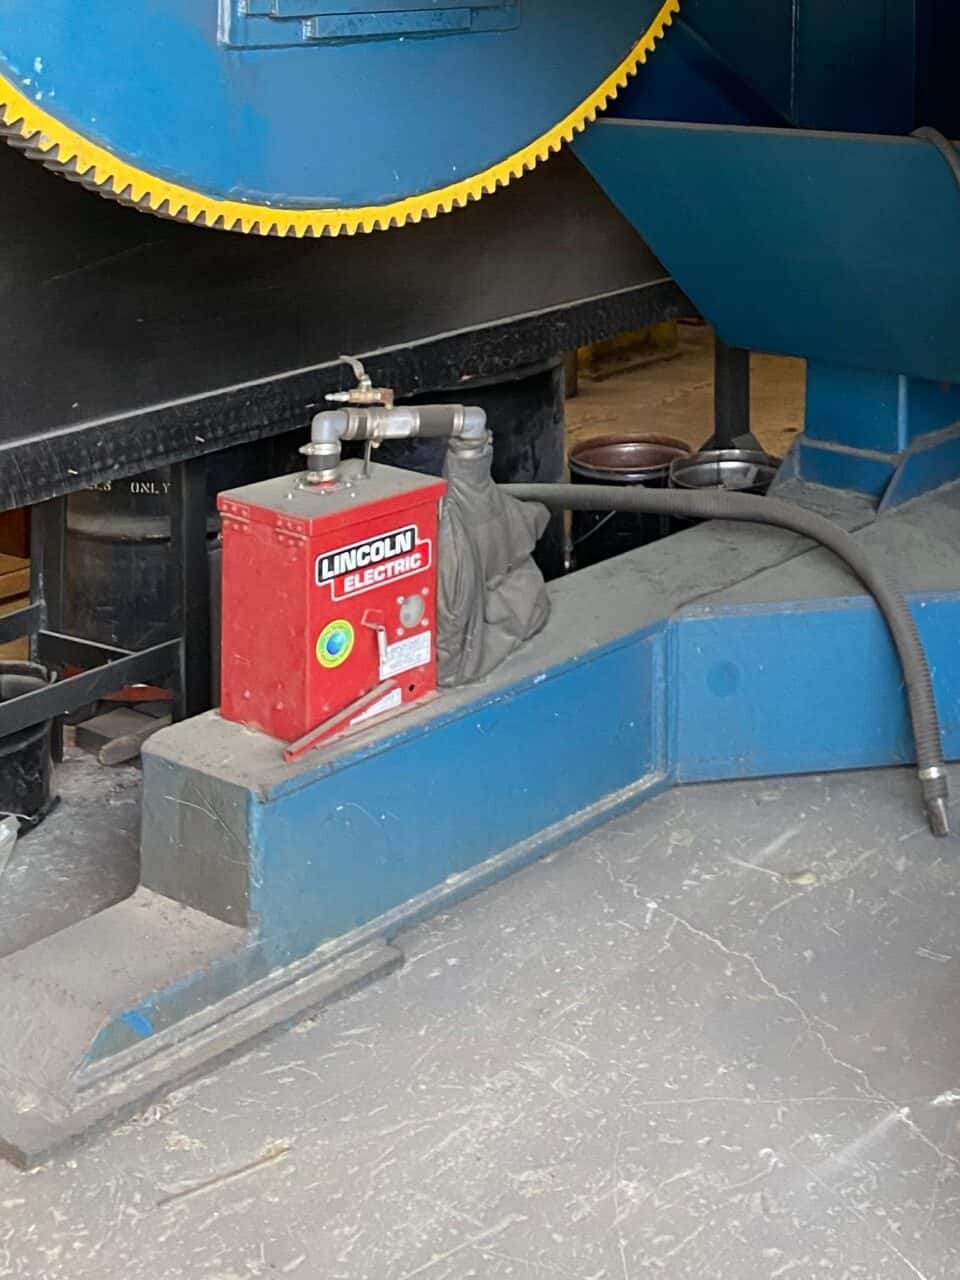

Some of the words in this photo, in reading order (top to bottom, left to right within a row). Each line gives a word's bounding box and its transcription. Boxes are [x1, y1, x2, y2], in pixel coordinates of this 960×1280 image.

[130, 482, 171, 494] ONLY
[321, 530, 413, 580] LINCOLN
[343, 552, 423, 594] ELECTRIC
